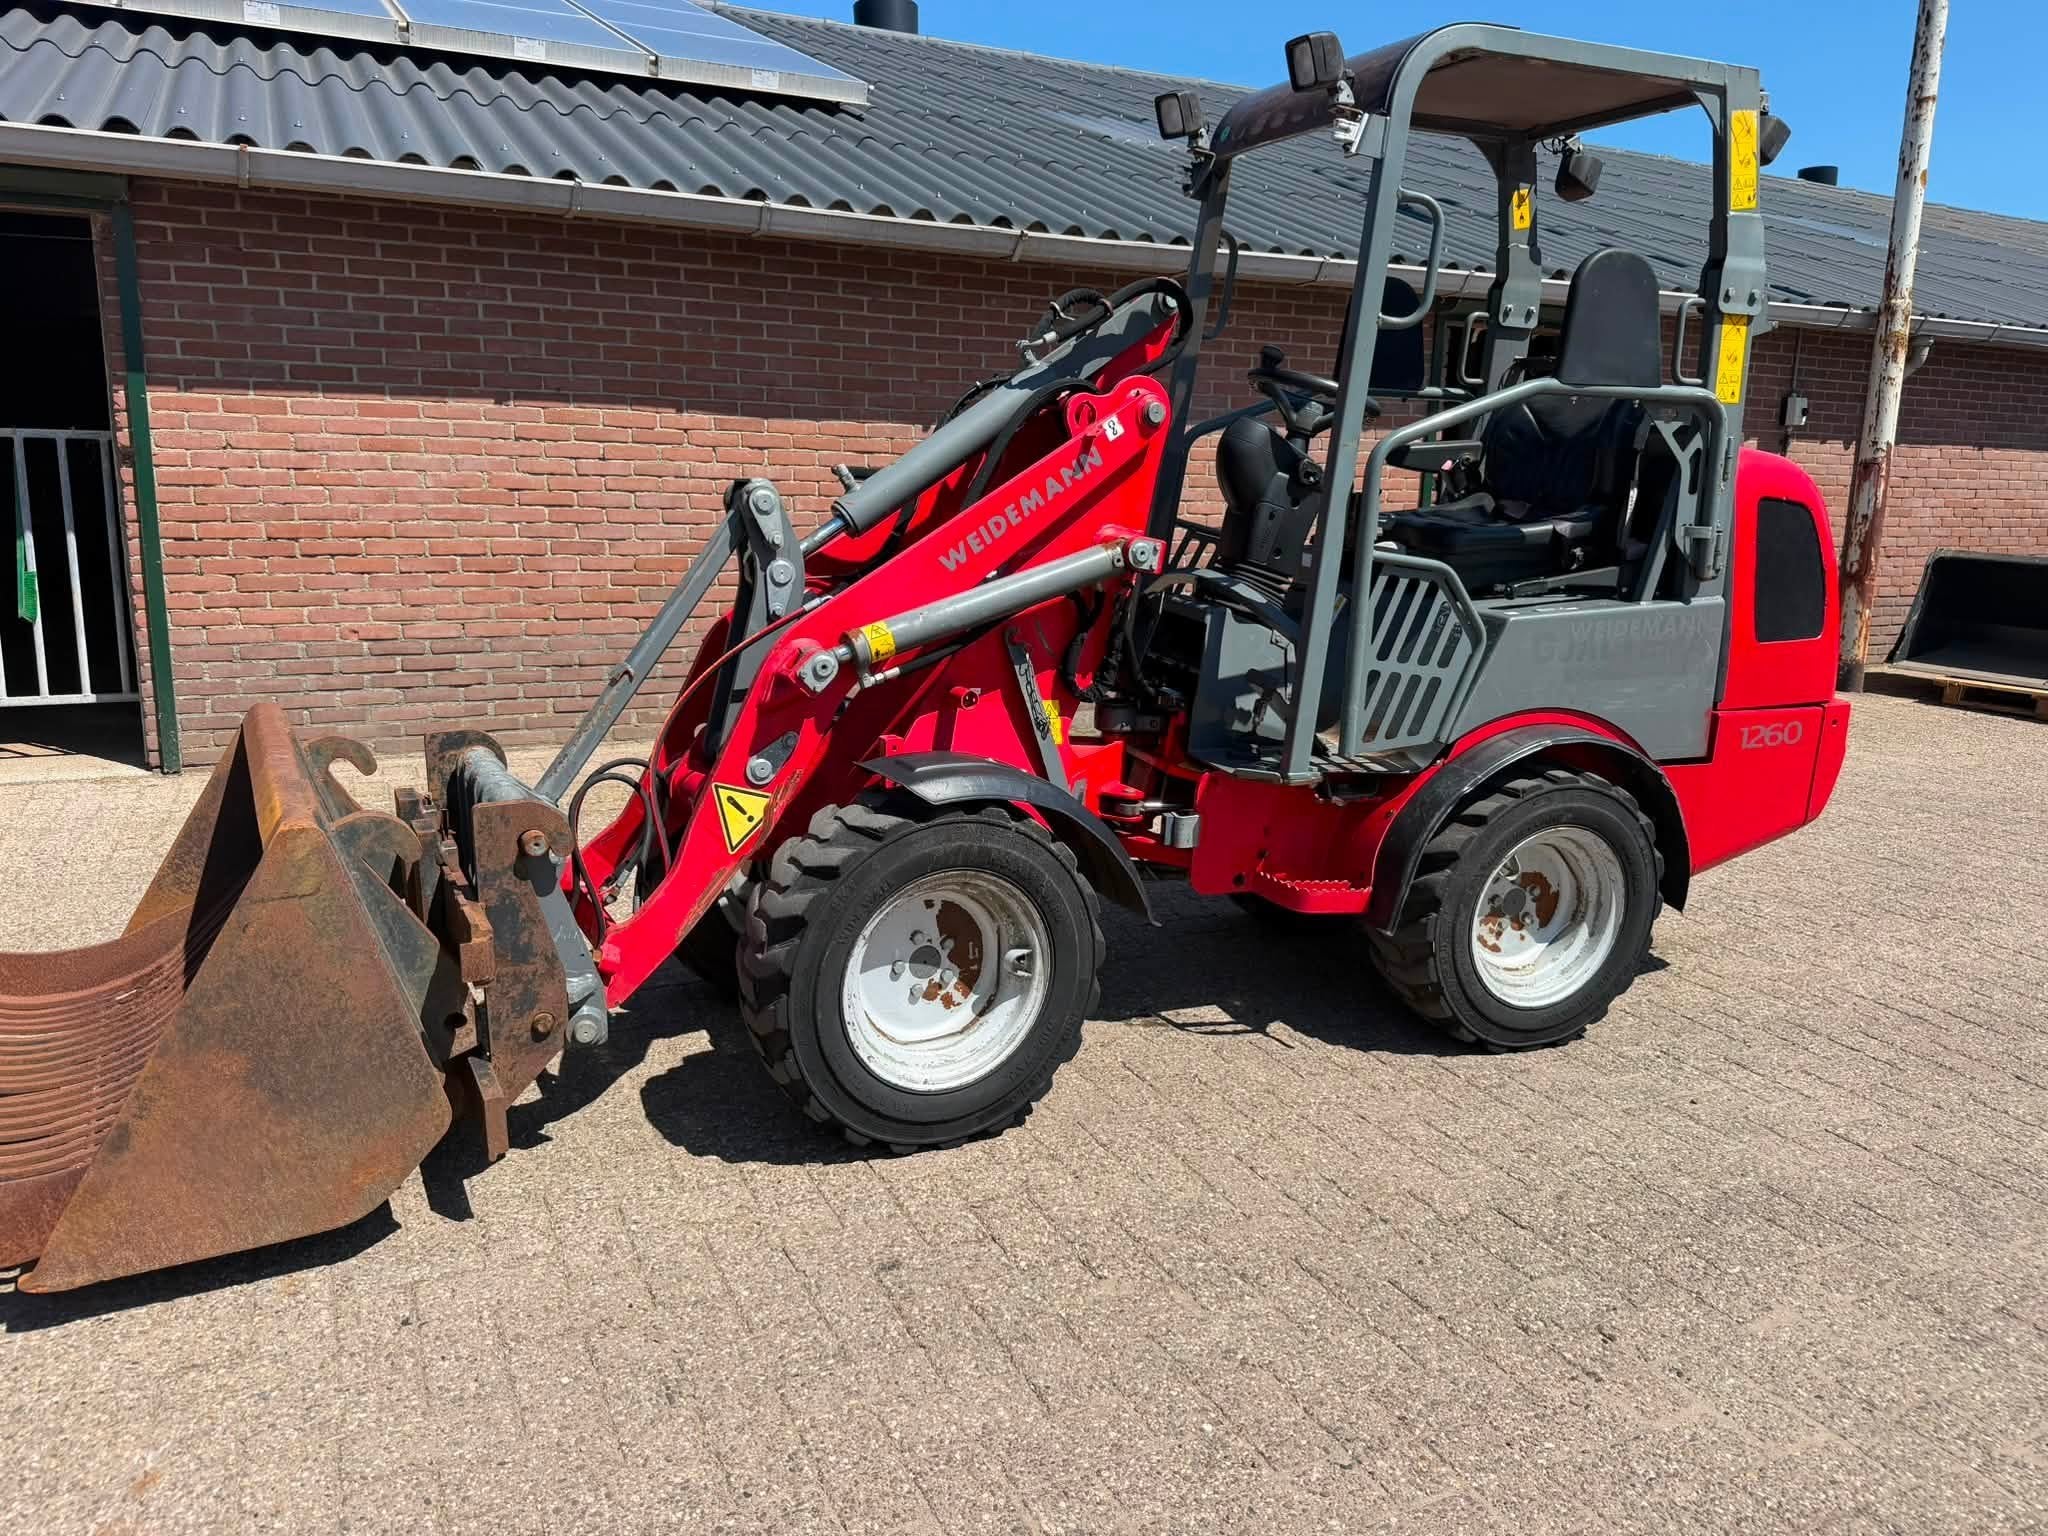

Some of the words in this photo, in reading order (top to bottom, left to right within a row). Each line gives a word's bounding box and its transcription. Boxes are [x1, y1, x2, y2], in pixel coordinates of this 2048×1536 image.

[938, 446, 1103, 572] WEIDEMANN
[1570, 612, 1710, 641] WEIDEMANN
[1740, 720, 1803, 750] 1260
